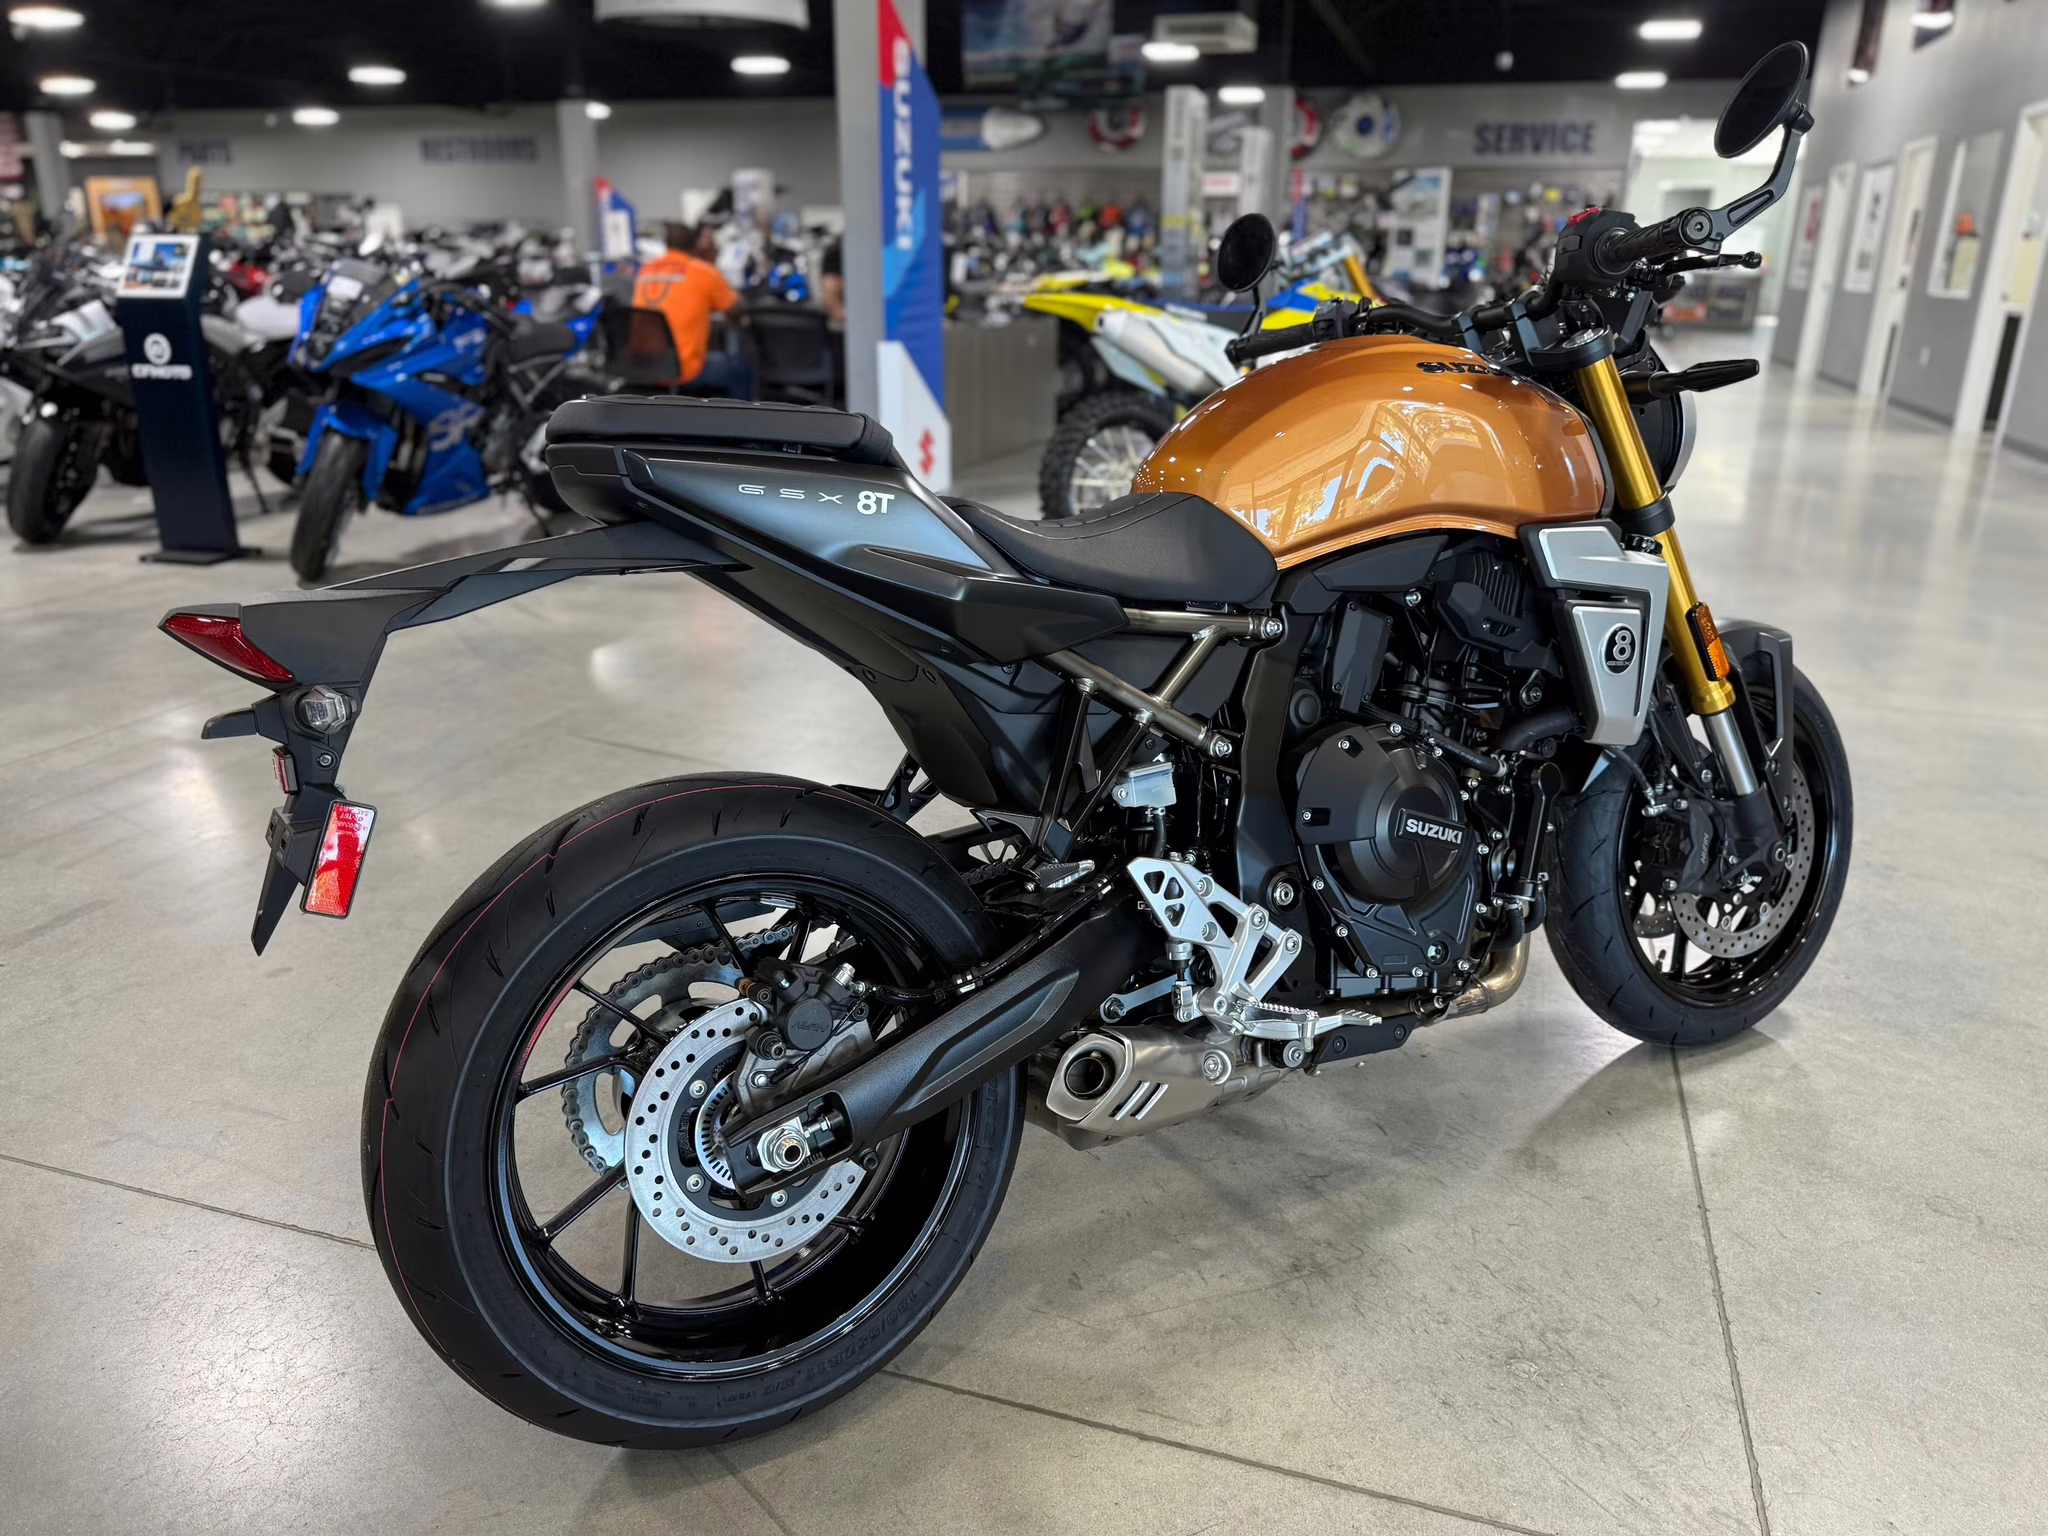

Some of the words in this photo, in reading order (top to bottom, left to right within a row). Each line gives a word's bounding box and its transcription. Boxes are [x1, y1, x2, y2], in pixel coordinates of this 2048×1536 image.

[893, 37, 914, 250] SUZUKI
[1475, 122, 1596, 154] SERVICE
[856, 490, 895, 515] 8T
[1613, 629, 1632, 661] 8
[1405, 818, 1463, 845] SUZUKI
